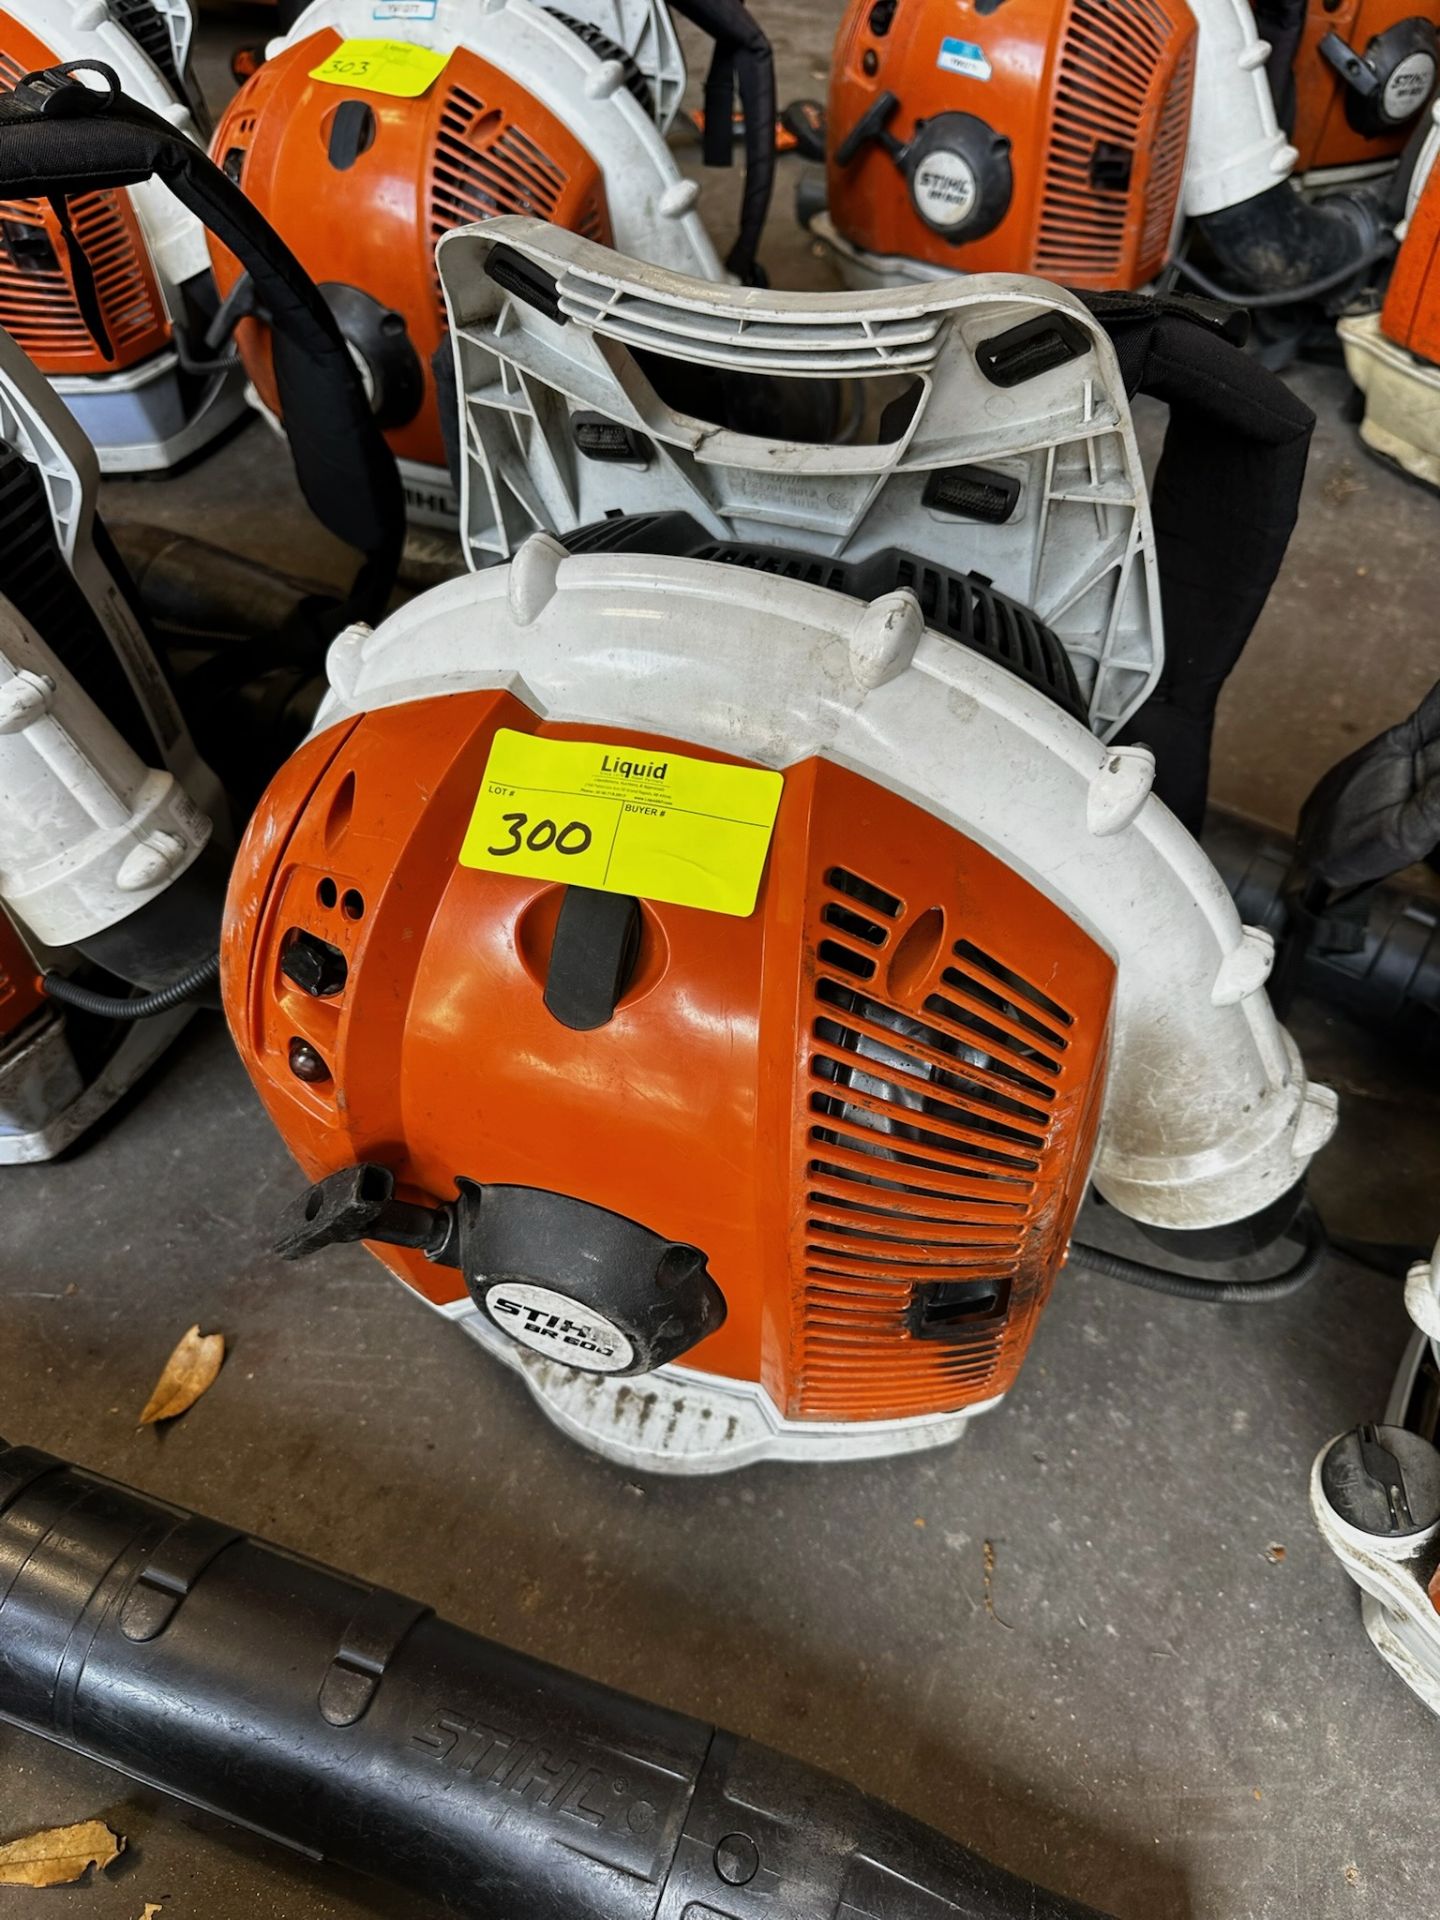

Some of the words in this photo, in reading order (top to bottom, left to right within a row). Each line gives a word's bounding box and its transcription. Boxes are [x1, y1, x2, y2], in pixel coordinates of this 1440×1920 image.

[321, 60, 370, 76] 303
[600, 755, 669, 780] Liquid
[488, 785, 508, 797] LOT
[624, 803, 658, 817] BUYER
[487, 812, 593, 857] 300
[493, 1297, 606, 1342] STIH
[523, 1322, 559, 1340] BR
[408, 1707, 606, 1829] STIHL
